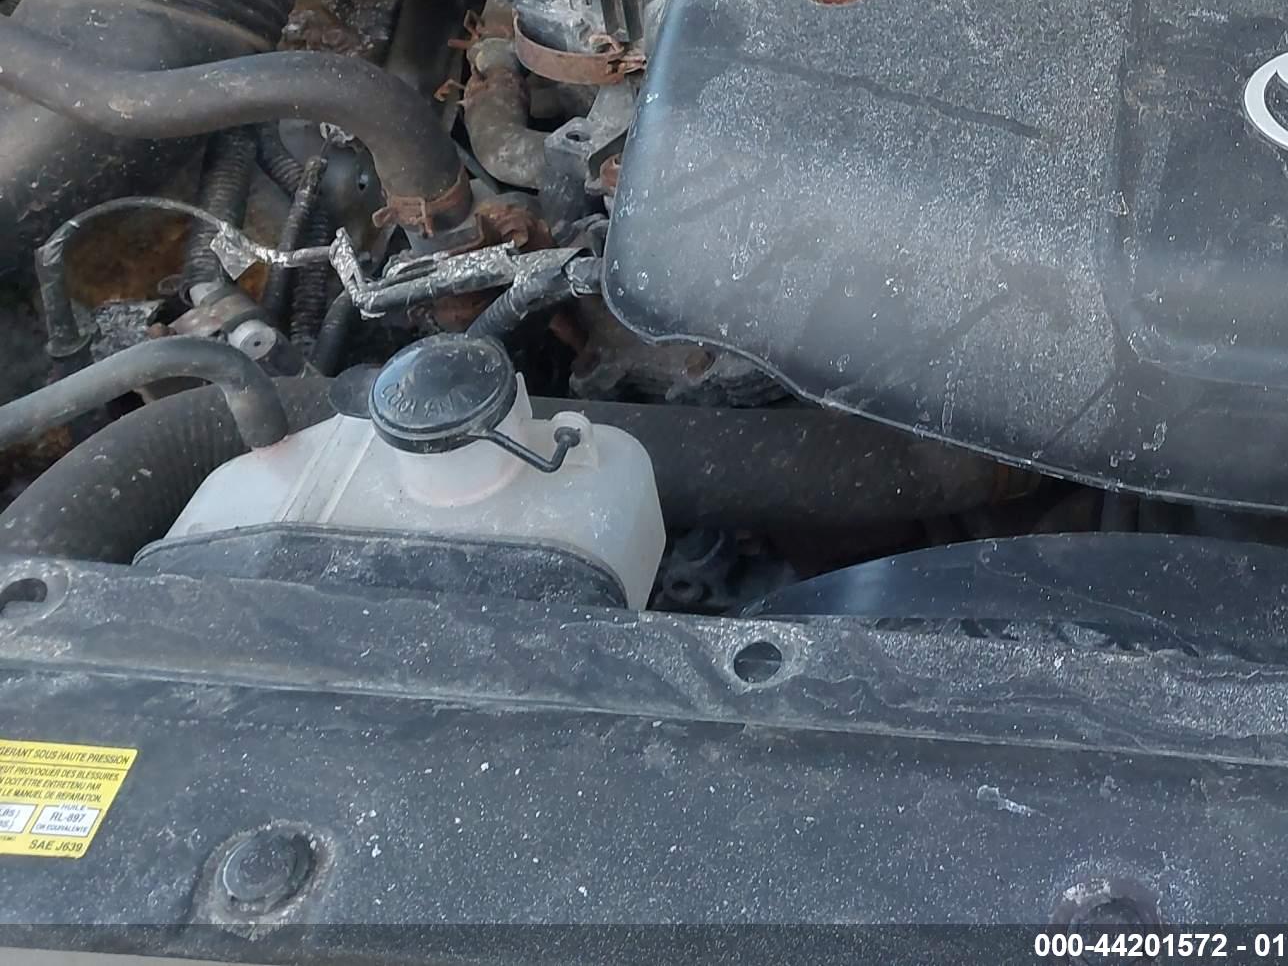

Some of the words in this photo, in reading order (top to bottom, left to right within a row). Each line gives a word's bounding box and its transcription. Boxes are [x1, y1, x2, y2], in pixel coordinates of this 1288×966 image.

[33, 749, 58, 760] SOUS
[57, 751, 88, 762] HAUTE
[87, 753, 130, 765] PRESSION
[15, 766, 61, 777] PROVOQUER
[60, 769, 77, 778] DES
[5, 777, 25, 786] DOIT
[42, 780, 87, 790] ENTRETENU
[86, 782, 102, 791] PAR
[14, 789, 43, 799] MANUEL
[44, 791, 58, 799] DE
[29, 839, 55, 851] SAE
[55, 840, 84, 852] J639
